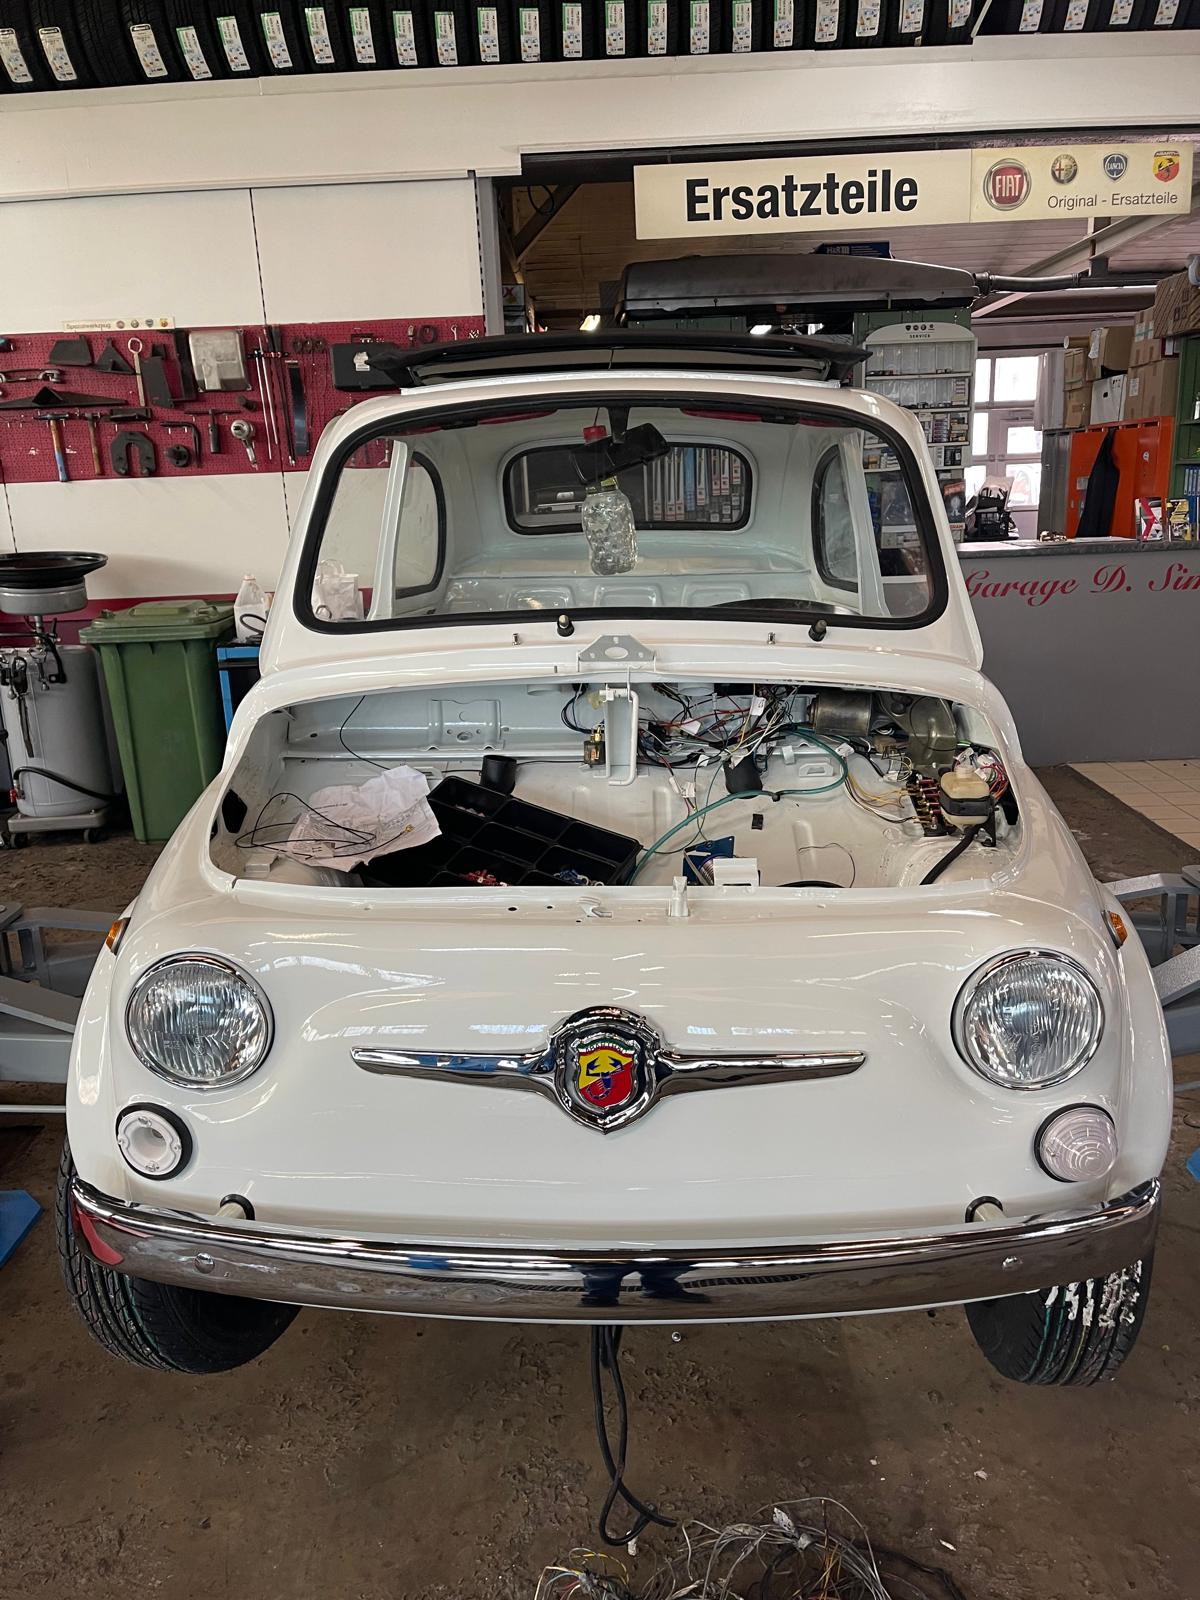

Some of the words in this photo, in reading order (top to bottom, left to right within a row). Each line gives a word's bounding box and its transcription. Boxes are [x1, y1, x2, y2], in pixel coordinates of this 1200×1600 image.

[686, 169, 918, 221] Ersatzteile
[995, 174, 1022, 198] FIAT
[1047, 194, 1097, 211] Original
[1111, 192, 1178, 206] Ersatzteile
[965, 569, 1080, 607] Garage
[1089, 563, 1132, 594] D.
